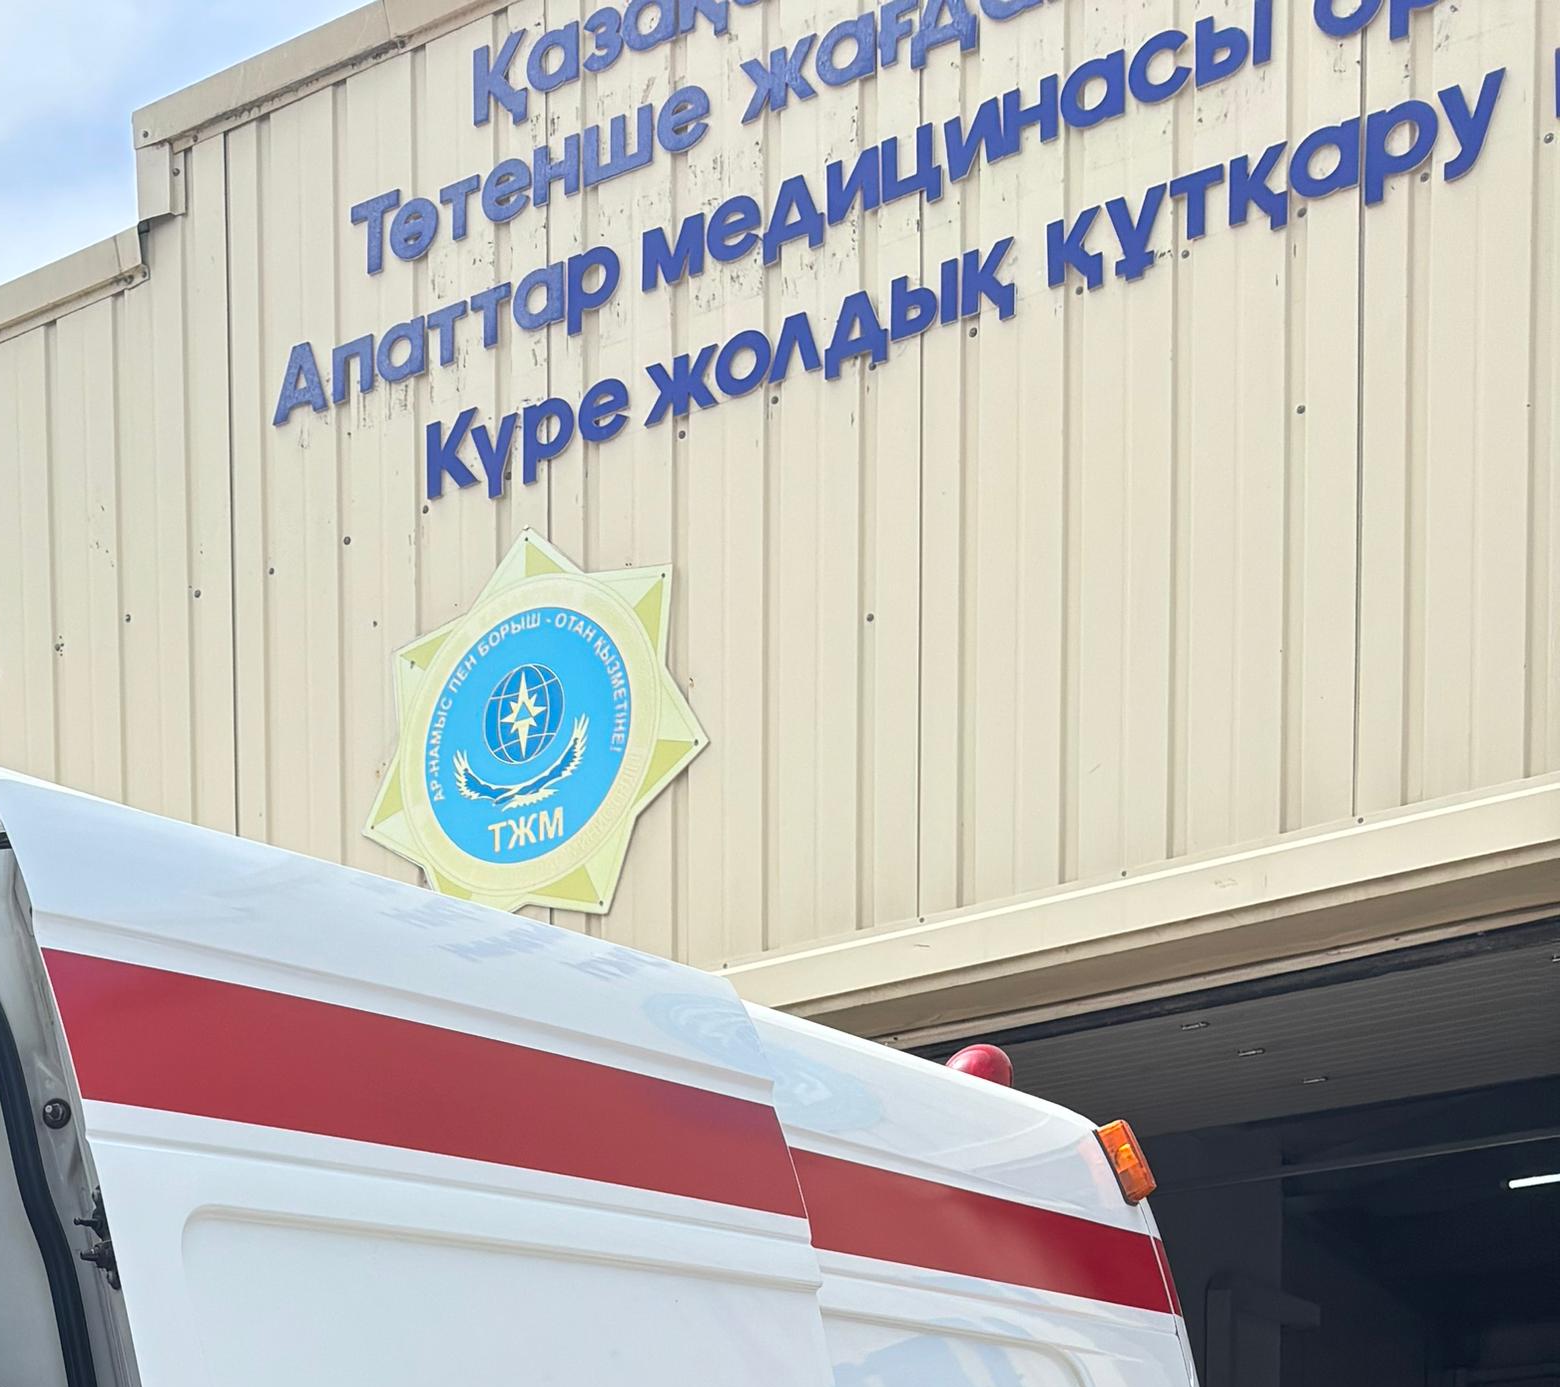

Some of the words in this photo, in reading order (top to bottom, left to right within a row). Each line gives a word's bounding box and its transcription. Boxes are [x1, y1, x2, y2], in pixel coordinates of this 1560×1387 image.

[473, 0, 762, 127] Қазақ
[273, 246, 621, 427] Апаттар
[642, 0, 1272, 292] медицинасы
[351, 85, 710, 275] Төтенше
[426, 378, 630, 500] Күре
[644, 236, 1016, 428] жолдық
[1046, 67, 1507, 290] құтқару
[477, 611, 541, 657] БОРЫШ
[554, 612, 597, 643] ОТАН
[488, 806, 564, 853] ТЖМ
